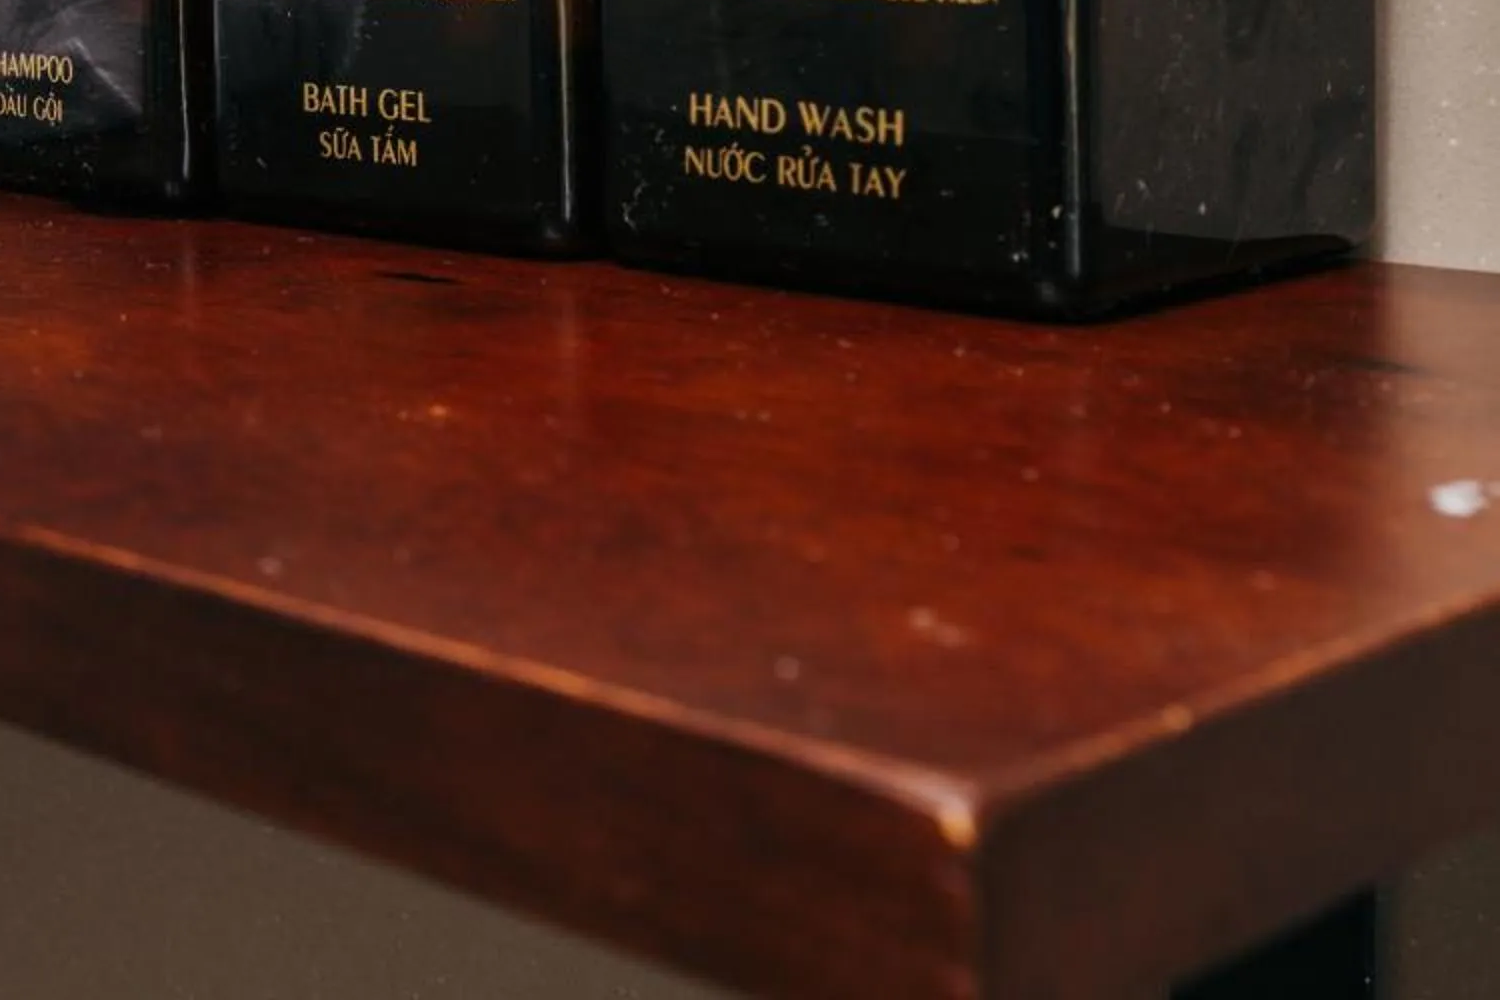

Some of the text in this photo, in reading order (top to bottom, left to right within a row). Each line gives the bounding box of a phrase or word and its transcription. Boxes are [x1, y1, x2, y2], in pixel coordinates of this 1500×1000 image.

[303, 83, 432, 124] BATH GEL
[689, 92, 905, 146] HAND WASH
[684, 142, 907, 199] NƯỚC RỬA TAY
